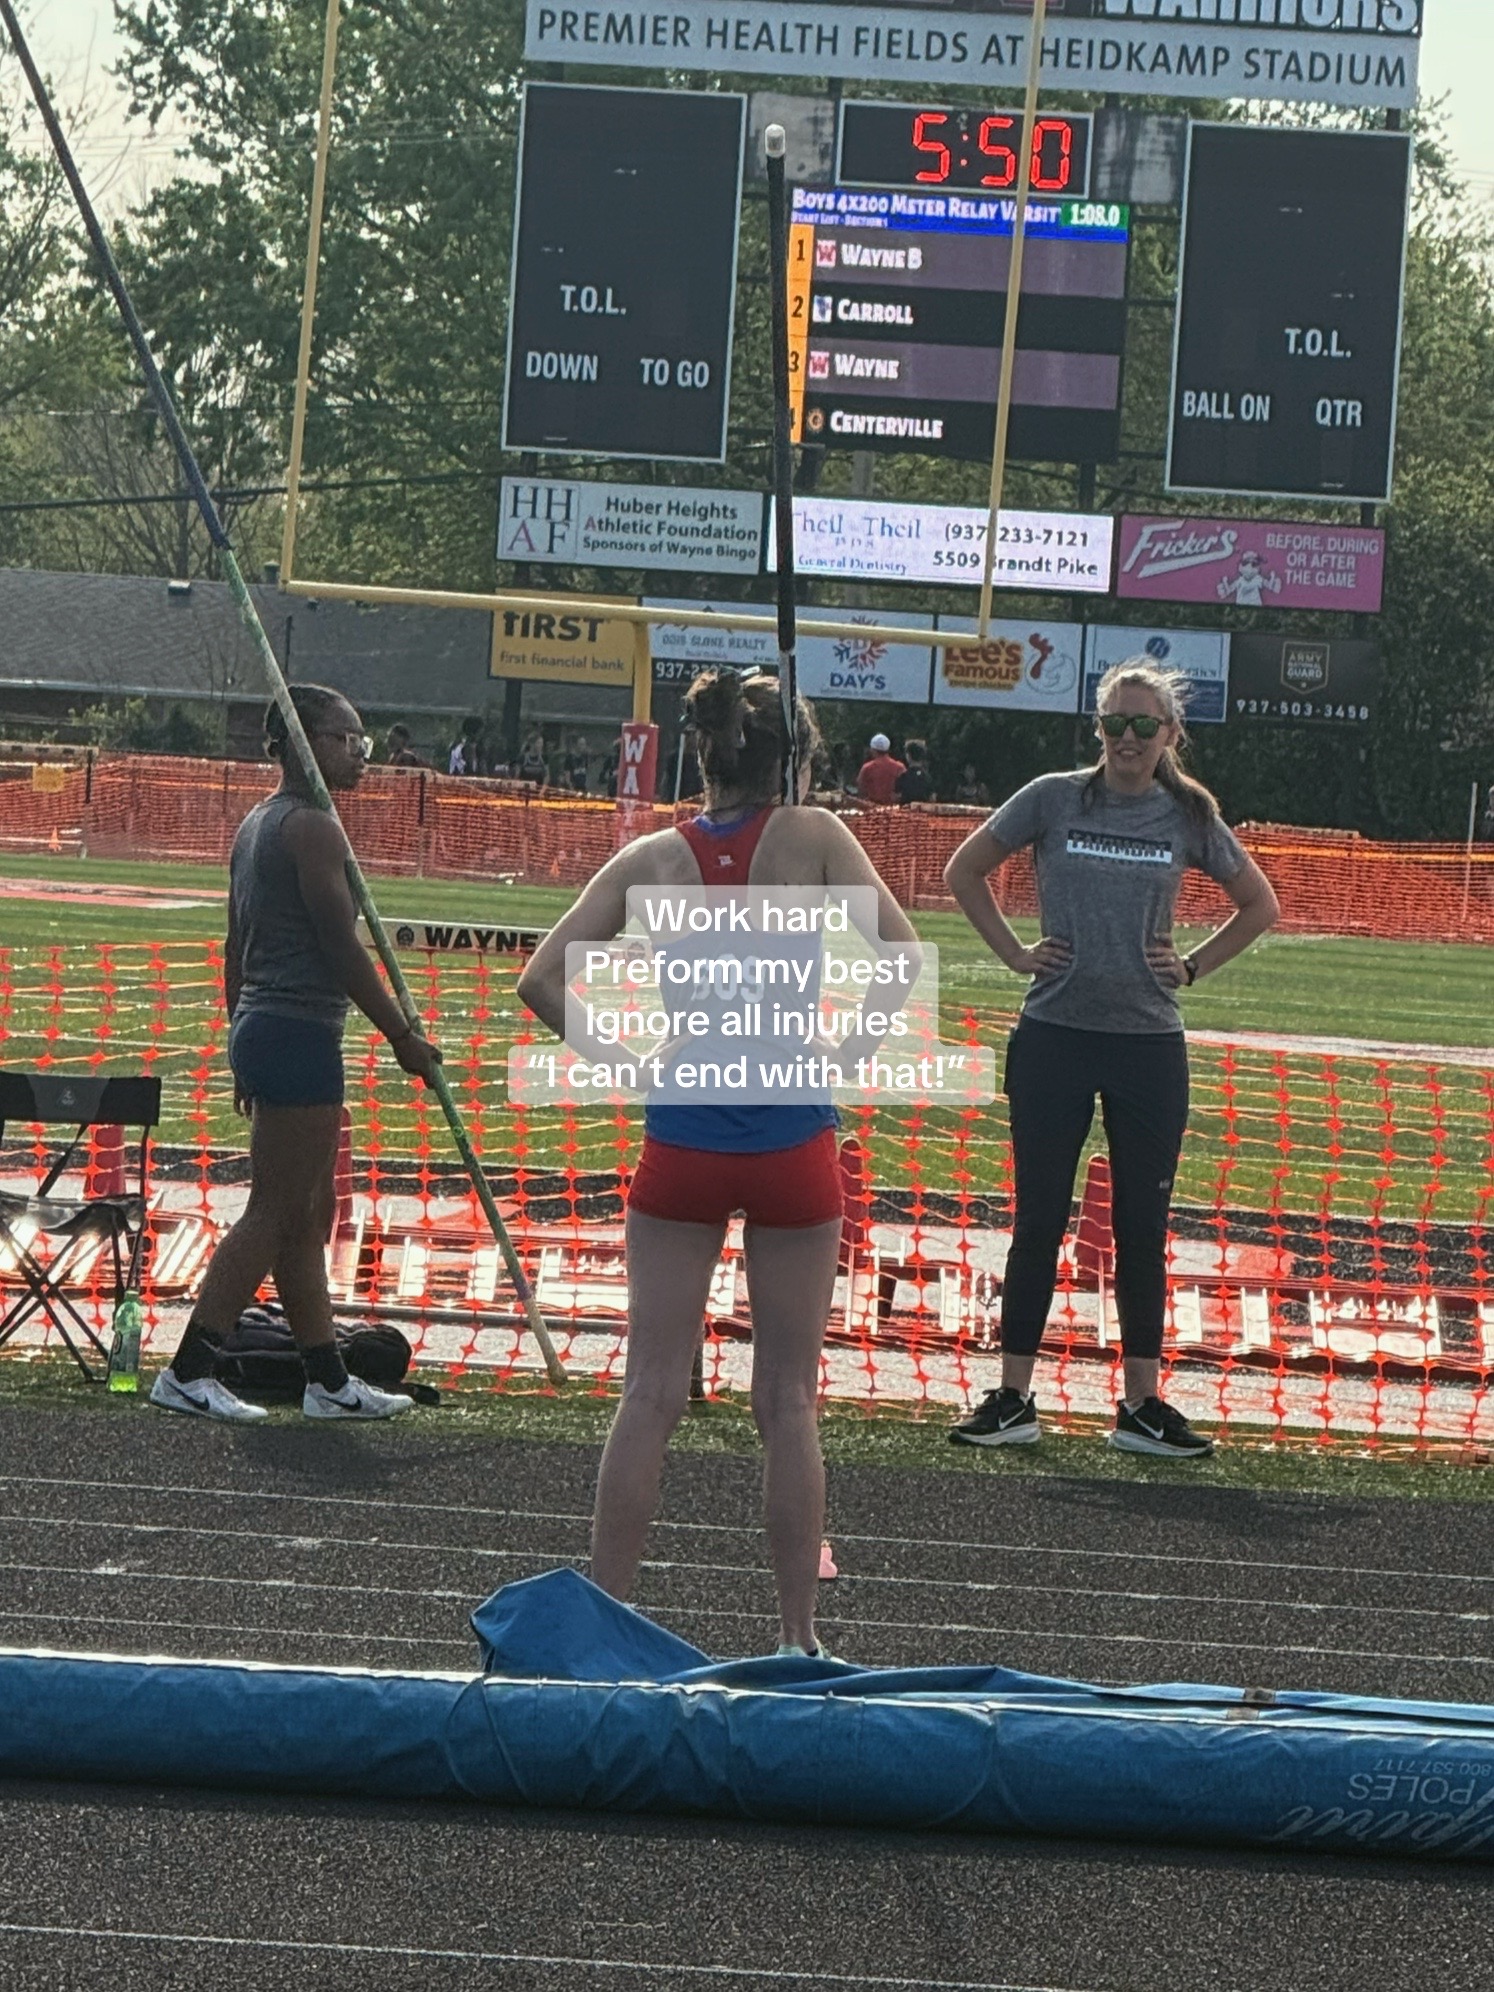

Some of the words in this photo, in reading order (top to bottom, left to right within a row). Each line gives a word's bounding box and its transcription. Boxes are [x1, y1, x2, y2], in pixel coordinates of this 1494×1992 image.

[538, 9, 691, 48] PREMIER
[706, 18, 838, 56] HEALTH
[854, 28, 968, 64] FIELDS
[981, 33, 1024, 66] AT
[1039, 35, 1229, 77] HEIDKAMP
[1244, 47, 1406, 87] STADIUM
[913, 113, 1072, 190] 5:50
[792, 187, 835, 209] BOYS
[891, 194, 945, 217] METER
[948, 197, 999, 220] RELAY
[1071, 203, 1120, 227] 1:08.0
[797, 239, 805, 262] 1
[841, 243, 906, 268] WAYNE
[907, 246, 923, 270] B
[560, 284, 627, 315] T.O.L.
[792, 295, 804, 318] 2
[837, 299, 914, 325] CARROLL
[1285, 328, 1352, 358] T.O.L.
[526, 351, 598, 381] DOWN
[640, 358, 669, 386] TO
[677, 360, 709, 387] GO
[789, 351, 800, 373] 3
[834, 353, 900, 380] WAYNE
[1183, 390, 1234, 419] BALL
[1241, 394, 1270, 422] ON
[1316, 398, 1363, 427] QTR
[830, 411, 943, 439] CENTERVILLE
[605, 497, 662, 516] Huber
[667, 500, 738, 521] Heights
[584, 517, 651, 535] Athletic
[657, 521, 758, 541] Foundation
[945, 523, 988, 542] (937
[998, 526, 1089, 547] 233-7121
[583, 536, 646, 553] Sponsors
[649, 540, 663, 553] of
[666, 543, 712, 559] Wayne
[716, 545, 756, 562] Bingo
[1122, 519, 1238, 573] Fricker's
[1327, 537, 1379, 555] DURING
[932, 550, 981, 568] 5509
[1057, 557, 1099, 576] Pike
[1287, 553, 1306, 567] OR
[1311, 554, 1356, 570] AFTER
[1284, 569, 1311, 585] THE
[1315, 571, 1356, 588] GAME
[500, 651, 527, 664] first
[531, 653, 587, 669] financial
[592, 656, 624, 671] bank
[1289, 651, 1322, 662] ARMY
[830, 672, 886, 690] DAY'S
[1287, 667, 1323, 679] GUARD
[425, 926, 539, 953] WAYNE
[1348, 1772, 1476, 1805] POLES
